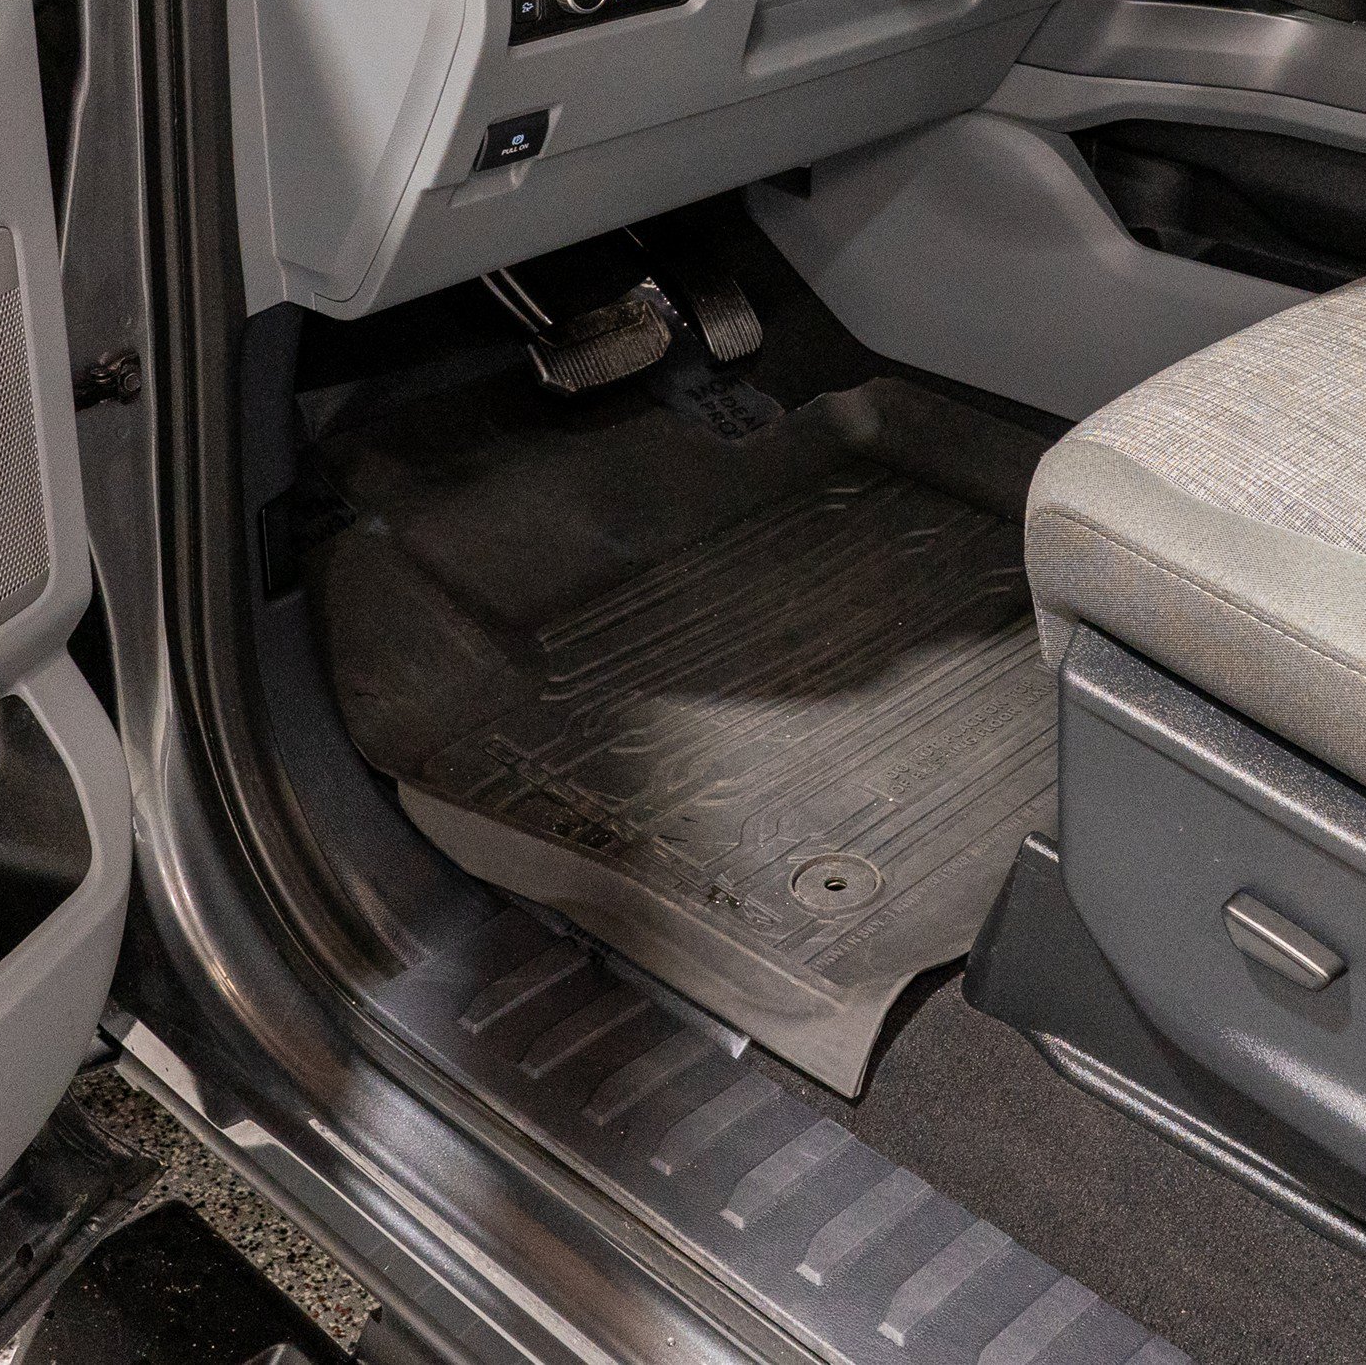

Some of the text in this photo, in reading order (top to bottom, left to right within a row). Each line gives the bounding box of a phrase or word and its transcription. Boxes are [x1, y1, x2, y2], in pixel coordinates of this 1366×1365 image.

[501, 143, 529, 155] PULL ON
[943, 712, 986, 745] PLACE
[976, 707, 1023, 738] FLOOR
